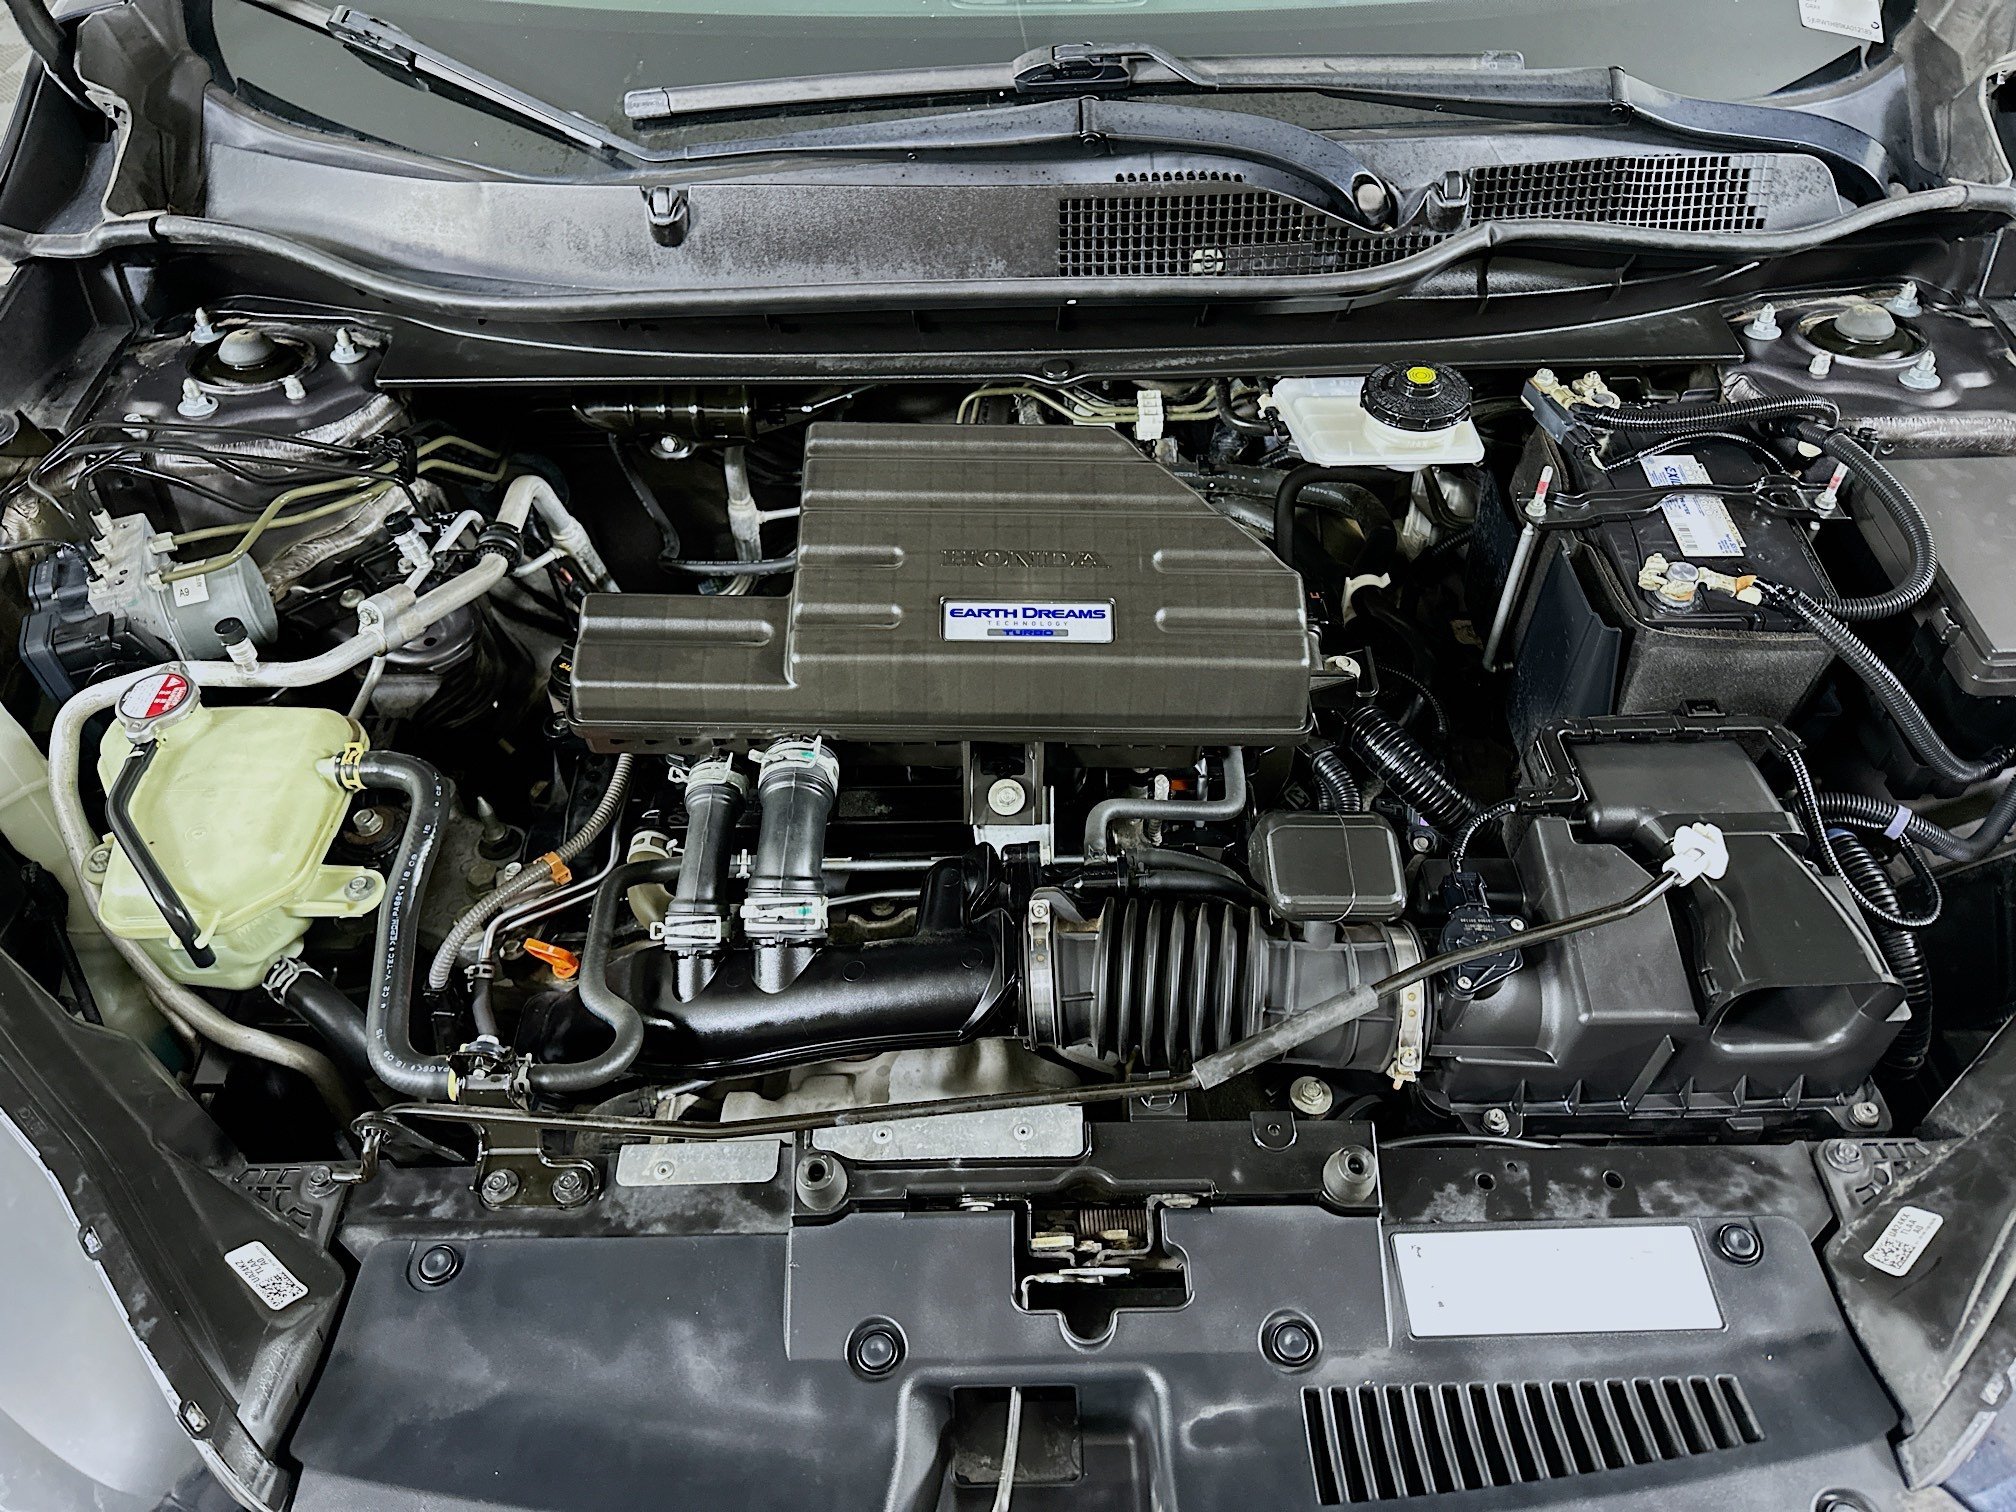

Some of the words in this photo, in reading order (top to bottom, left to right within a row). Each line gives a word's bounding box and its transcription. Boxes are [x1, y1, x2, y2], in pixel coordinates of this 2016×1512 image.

[940, 550, 1111, 569] HONDA
[180, 588, 190, 597] A9
[950, 608, 1017, 618] EARTH
[1022, 607, 1106, 619] DREAMS
